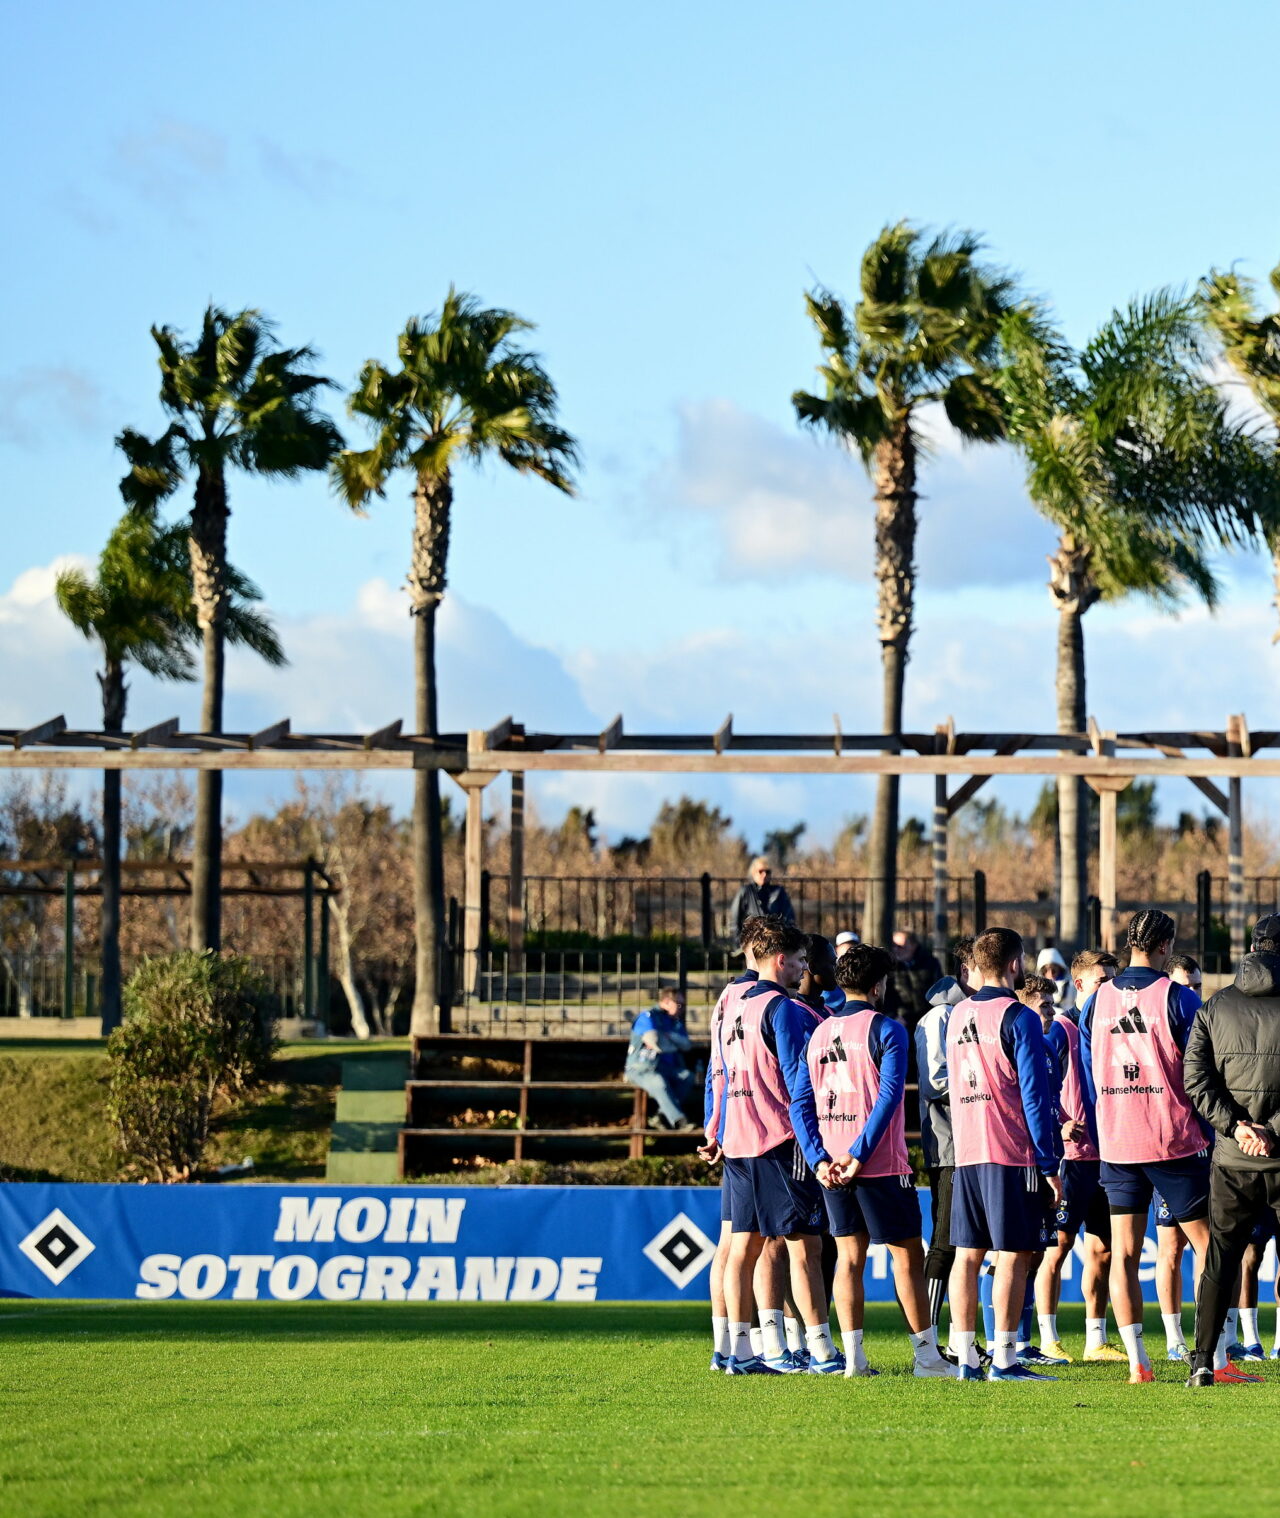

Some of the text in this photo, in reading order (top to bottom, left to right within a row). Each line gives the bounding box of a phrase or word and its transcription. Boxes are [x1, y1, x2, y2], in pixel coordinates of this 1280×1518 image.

[1101, 1085, 1164, 1095] HanseMerkur
[274, 1197, 466, 1243] MOIN
[135, 1254, 603, 1301] SOTOGRANDE
